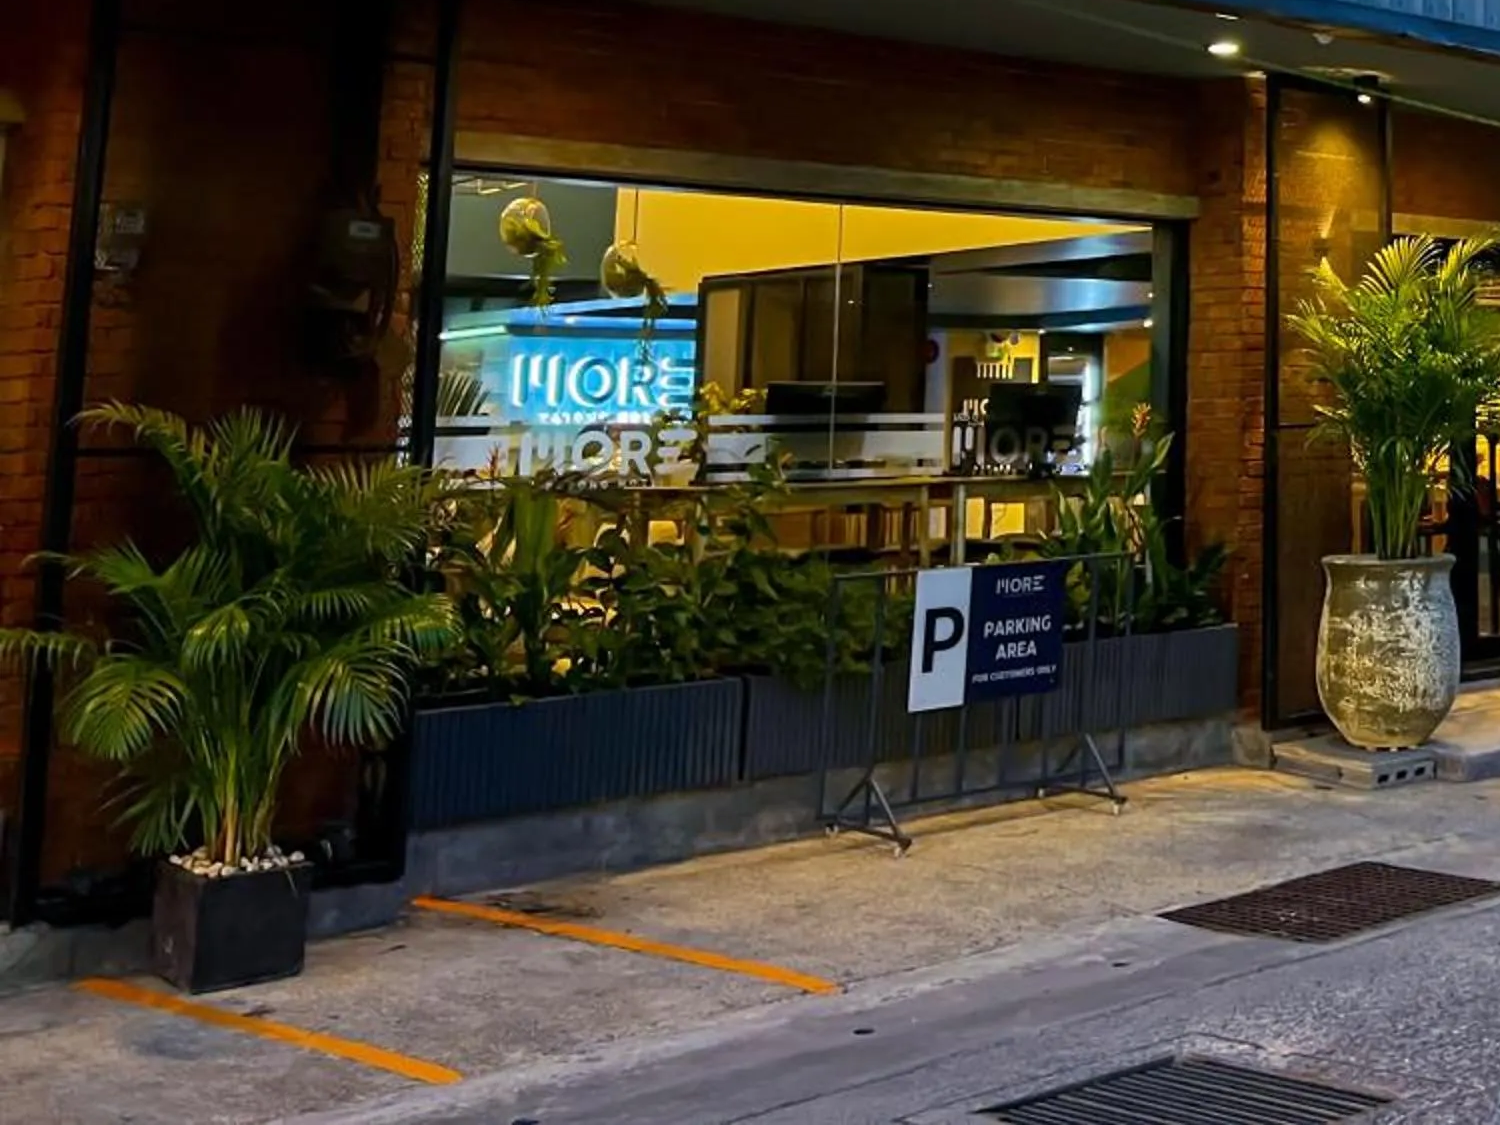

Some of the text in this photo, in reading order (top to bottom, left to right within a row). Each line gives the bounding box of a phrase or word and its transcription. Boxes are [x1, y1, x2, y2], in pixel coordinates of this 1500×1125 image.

[512, 353, 696, 408] MORE
[519, 429, 698, 476] MORE
[995, 575, 1045, 594] MORE
[922, 607, 964, 673] P
[984, 615, 1051, 638] PARKING
[996, 640, 1037, 660] AREA
